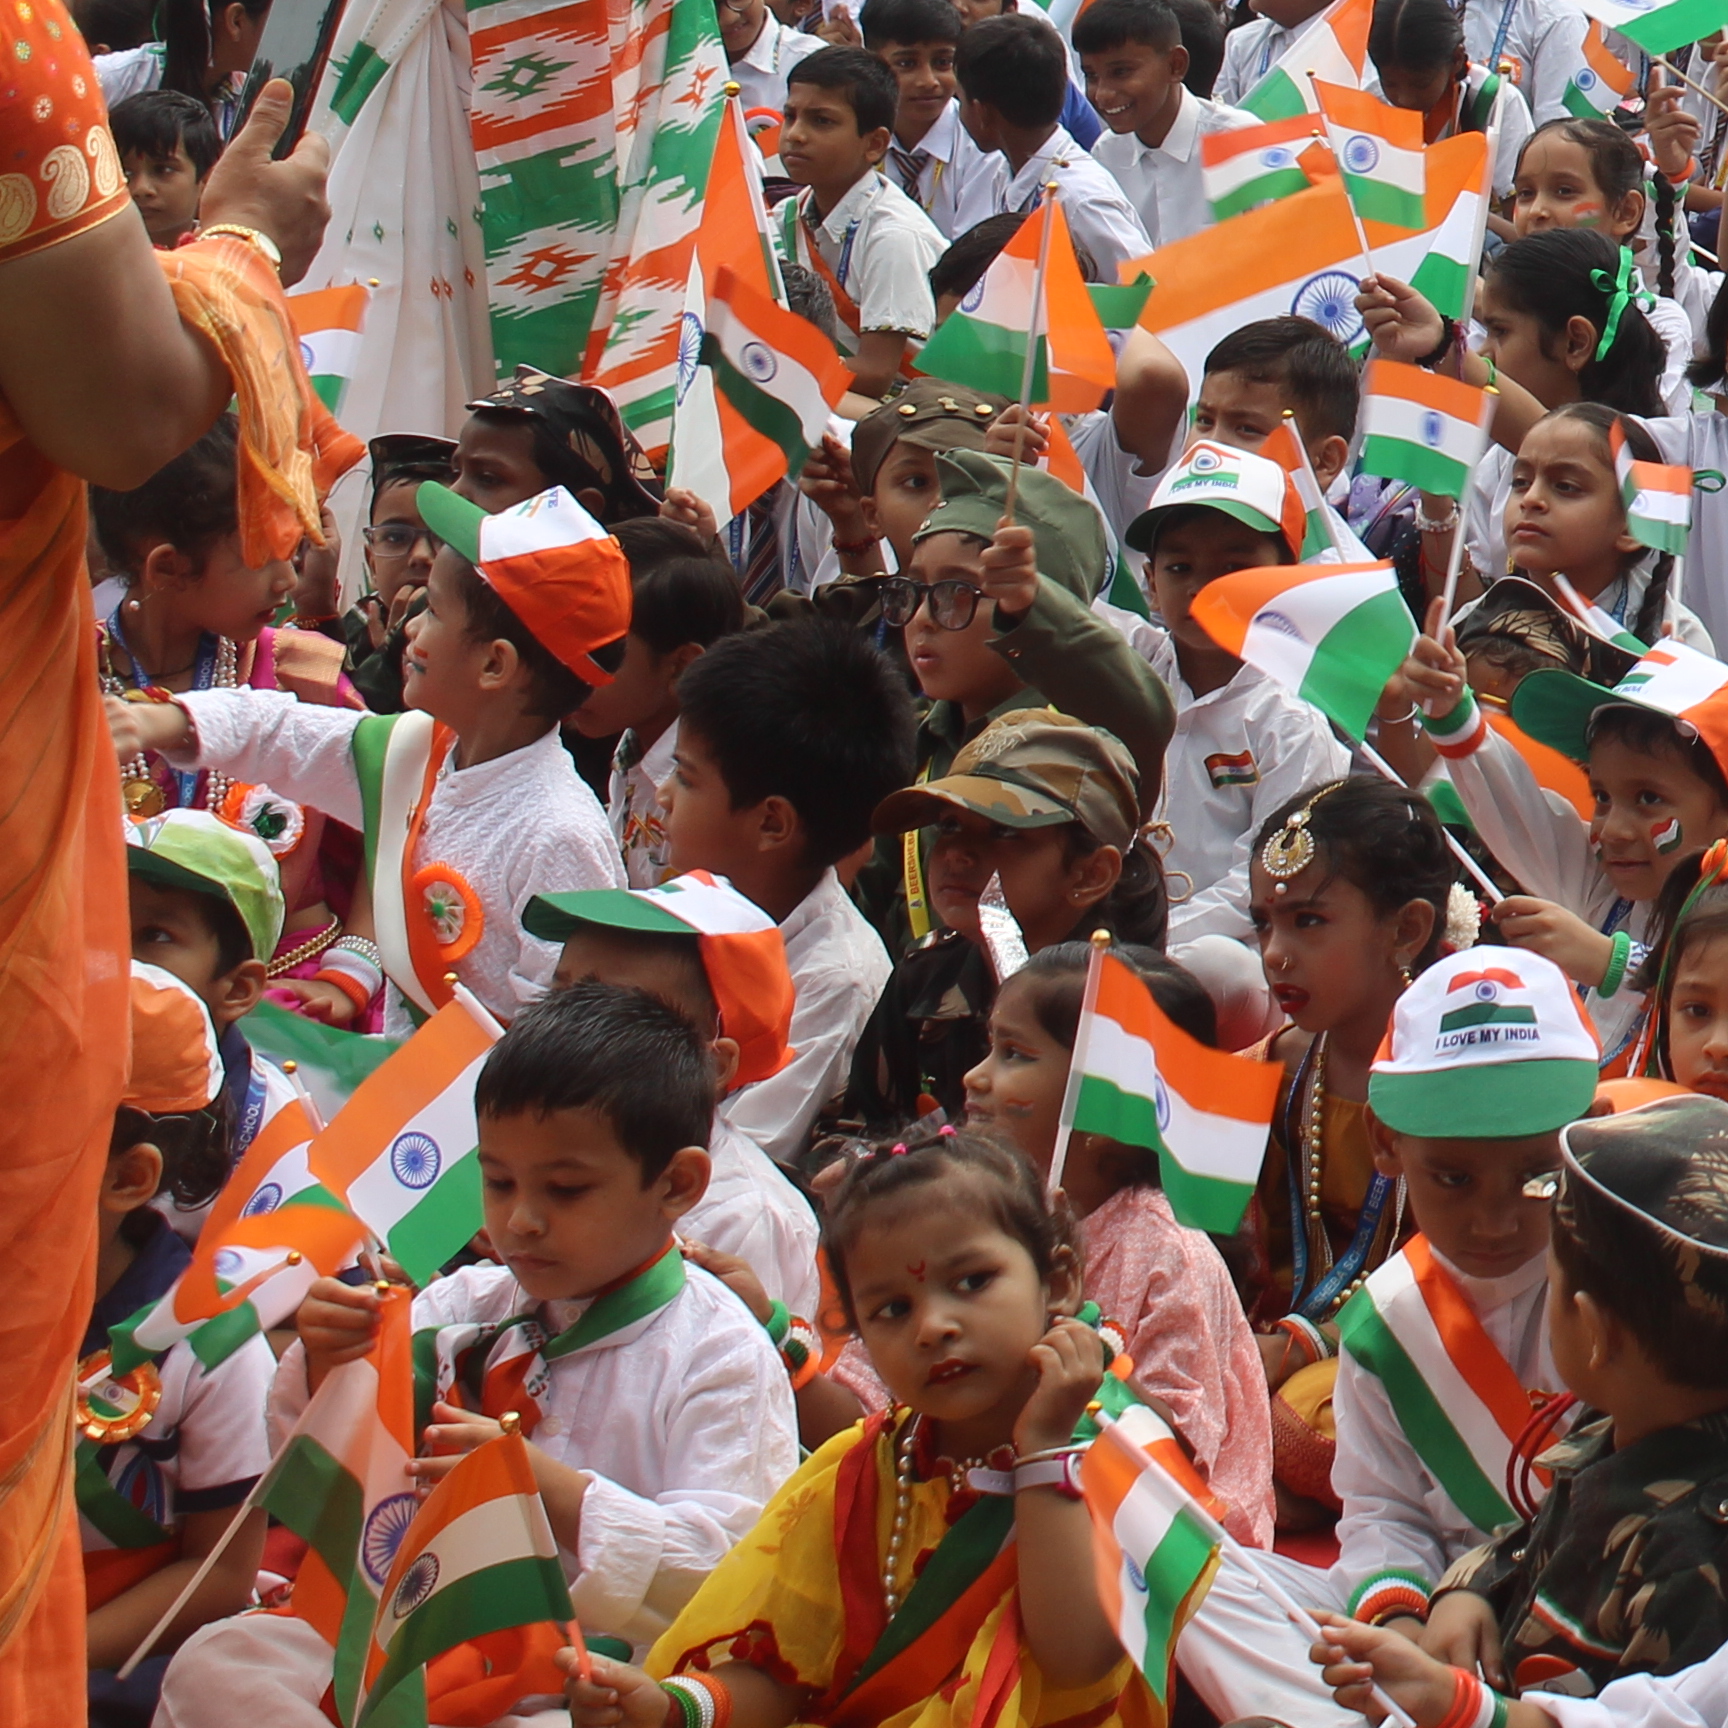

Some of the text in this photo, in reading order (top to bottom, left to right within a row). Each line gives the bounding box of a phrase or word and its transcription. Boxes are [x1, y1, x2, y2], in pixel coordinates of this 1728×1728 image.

[1435, 1027, 1540, 1050] I LOVE MY INDIA
[240, 1101, 260, 1152] SCHOOL
[1344, 1226, 1371, 1272] SCHOOL
